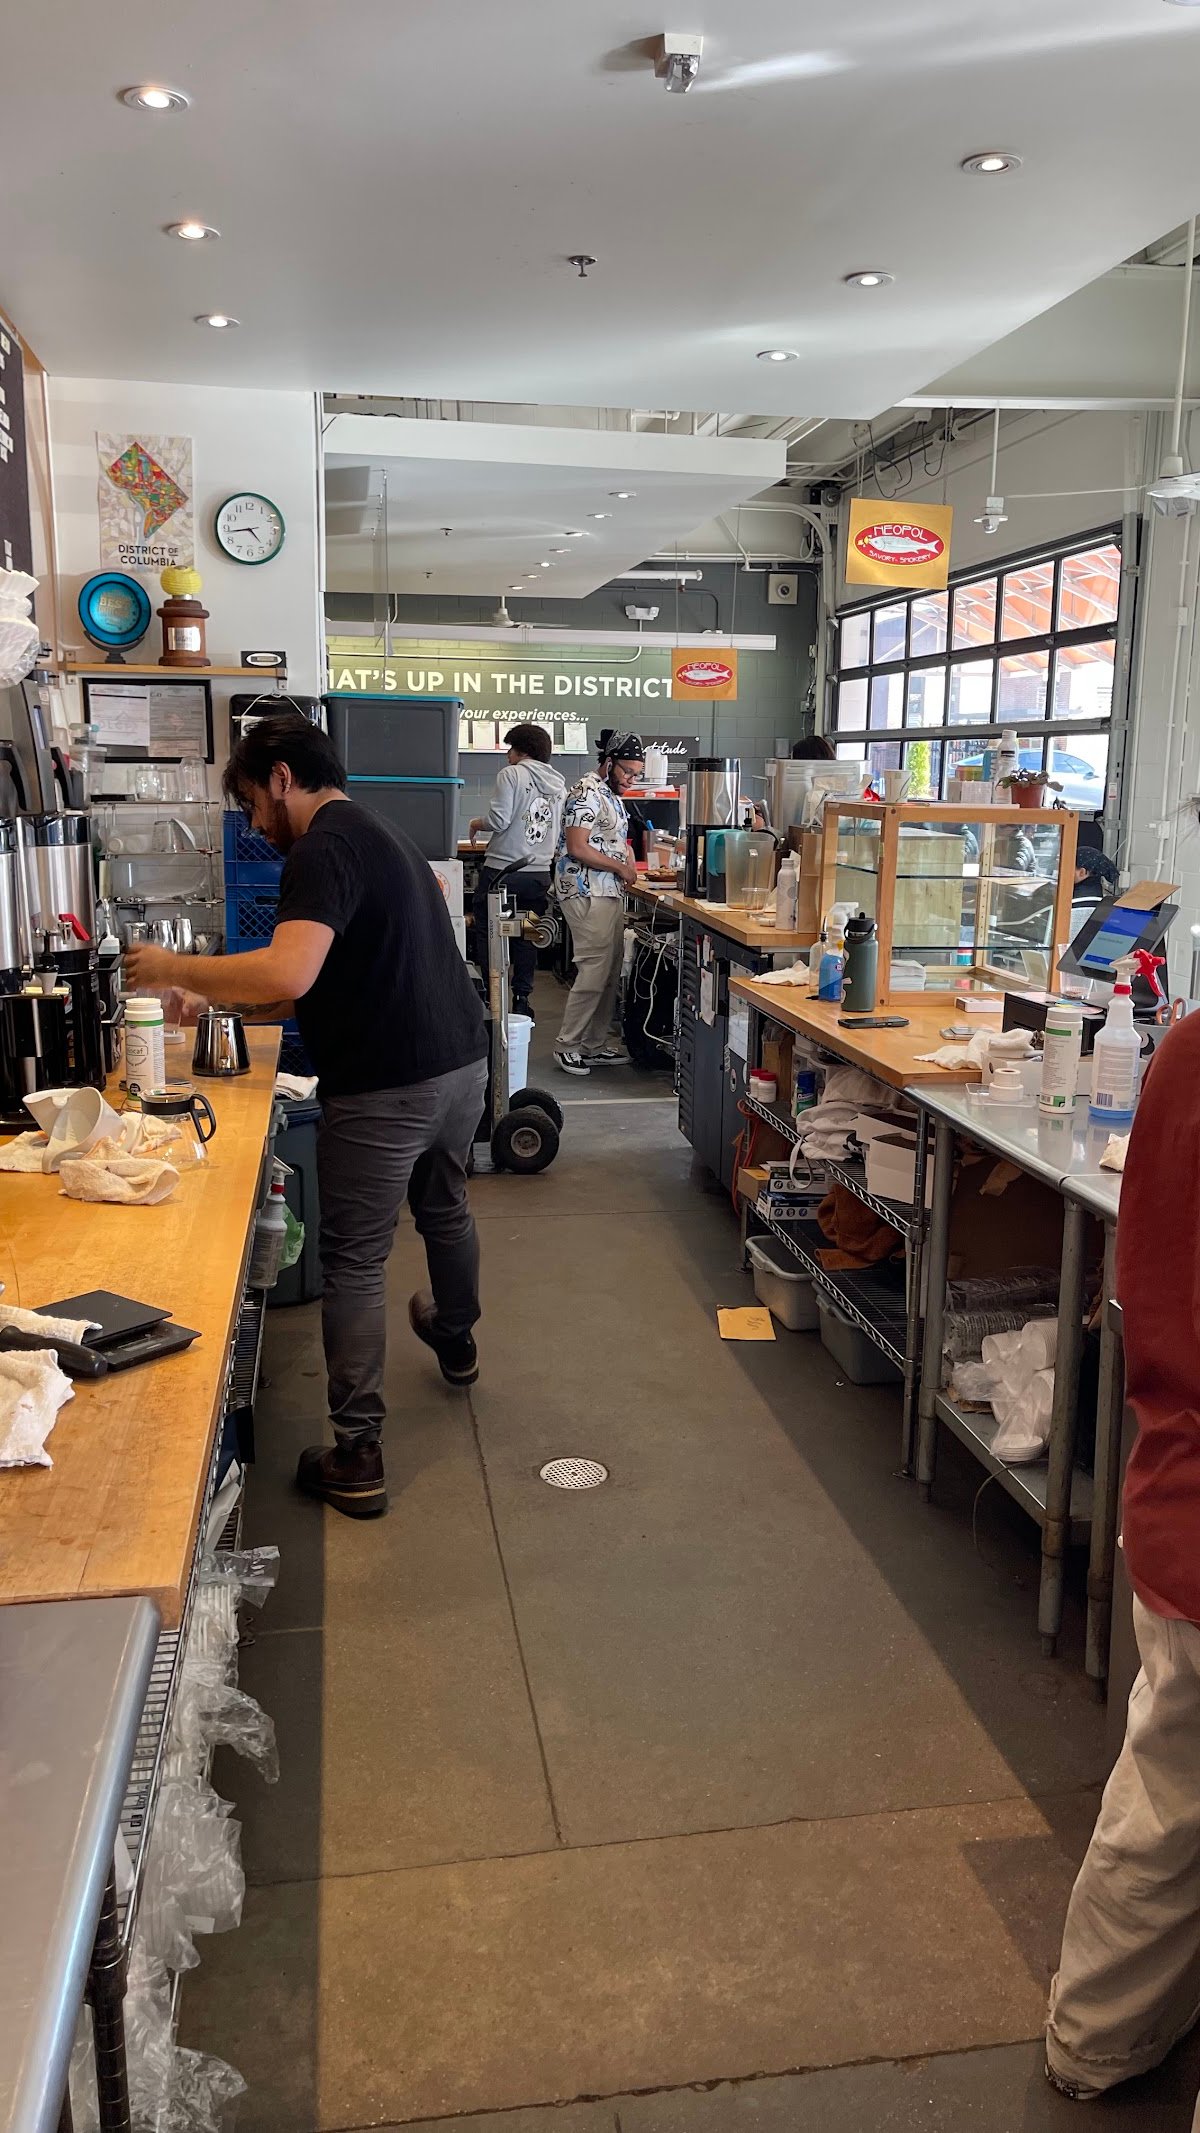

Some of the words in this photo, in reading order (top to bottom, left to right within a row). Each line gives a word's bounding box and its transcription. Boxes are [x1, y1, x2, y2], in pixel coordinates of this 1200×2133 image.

[235, 504, 242, 513] 11
[245, 501, 255, 511] 12
[226, 513, 237, 522] 10
[223, 523, 231, 533] 9
[873, 524, 928, 542] NEOPOL
[227, 536, 235, 545] 8
[265, 539, 273, 548] 4
[118, 544, 166, 556] DISTRICT
[168, 547, 179, 555] OF
[235, 545, 243, 554] 7
[246, 547, 254, 557] 6
[257, 546, 266, 555] 5
[120, 555, 177, 567] COLUMBIA
[407, 670, 445, 692] UP
[453, 672, 481, 693] IN
[490, 673, 545, 695] THE
[554, 675, 673, 698] DISTRICT
[492, 708, 590, 722] experiences...
